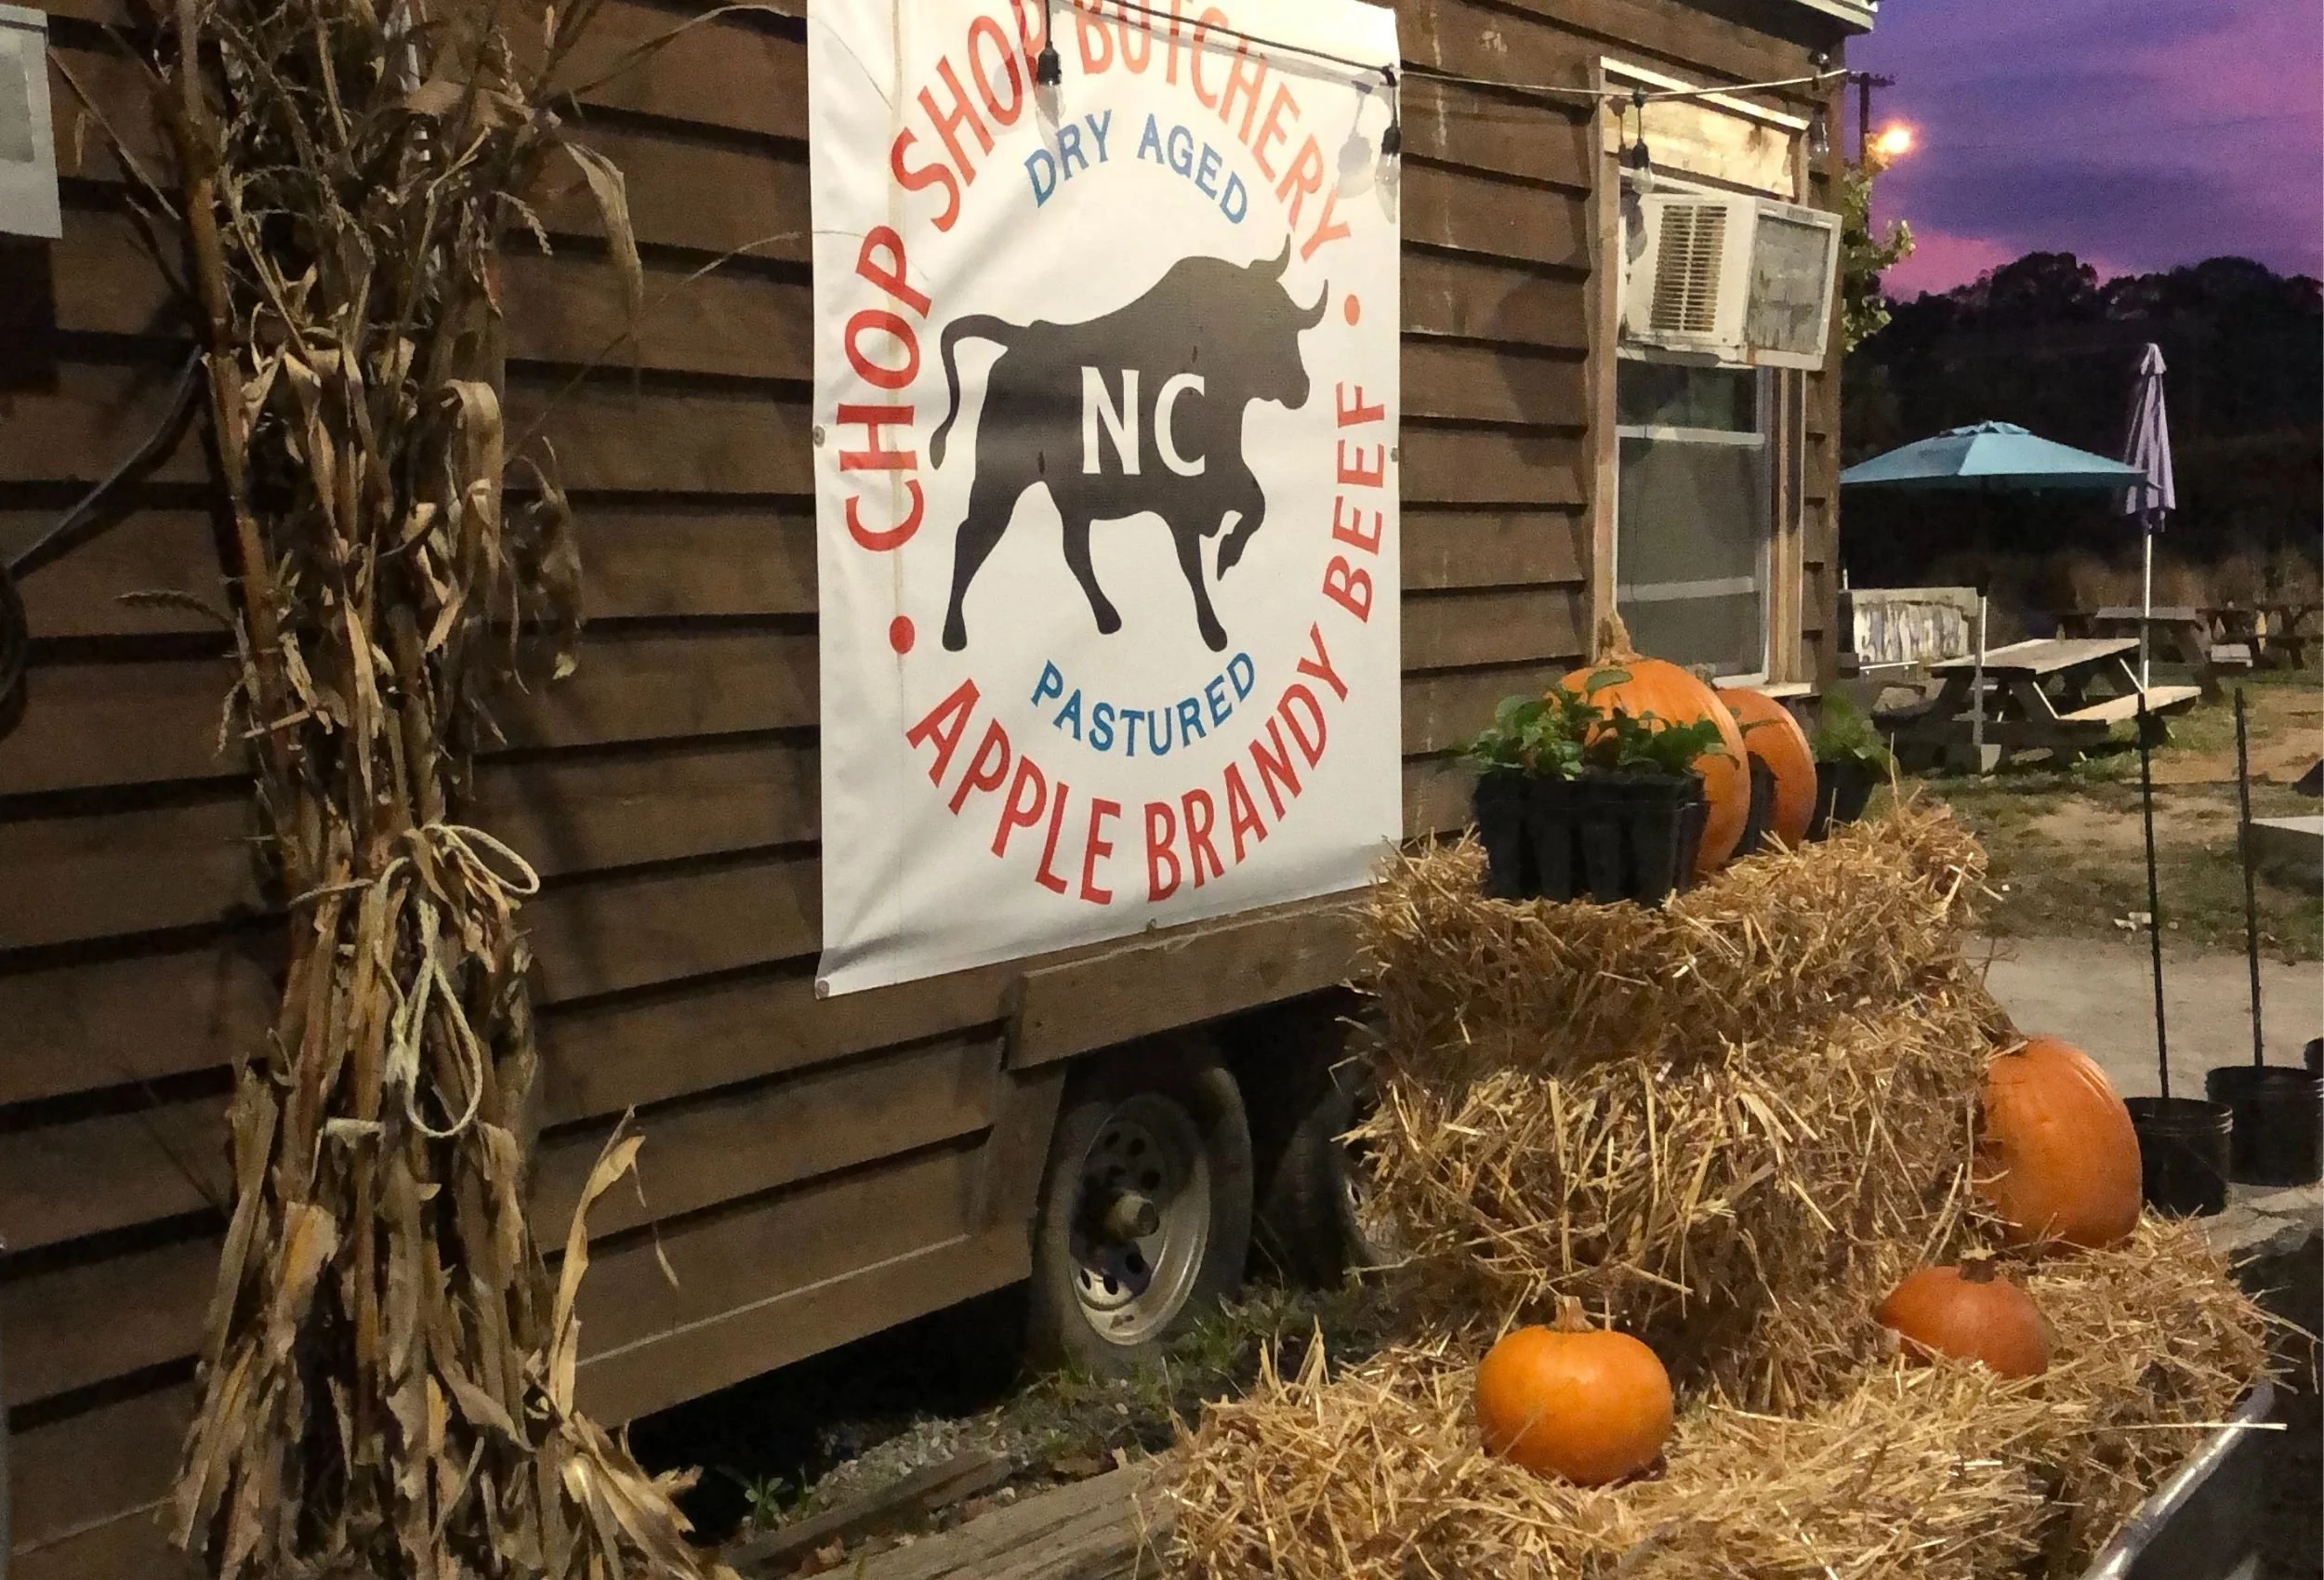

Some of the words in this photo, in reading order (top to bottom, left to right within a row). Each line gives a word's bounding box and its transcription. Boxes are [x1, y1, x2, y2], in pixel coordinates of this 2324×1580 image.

[1024, 109, 1112, 208] DRY
[1137, 112, 1248, 224] AGED
[837, 226, 932, 551] CHOP
[890, 0, 1050, 232] SHOP
[1069, 0, 1351, 262] BUTCHERY
[1081, 365, 1206, 476] NC
[905, 678, 1122, 905] APPLE
[1143, 621, 1349, 903] BRANDY
[1322, 381, 1385, 623] BEEF
[1030, 652, 1255, 757] PASTURED
